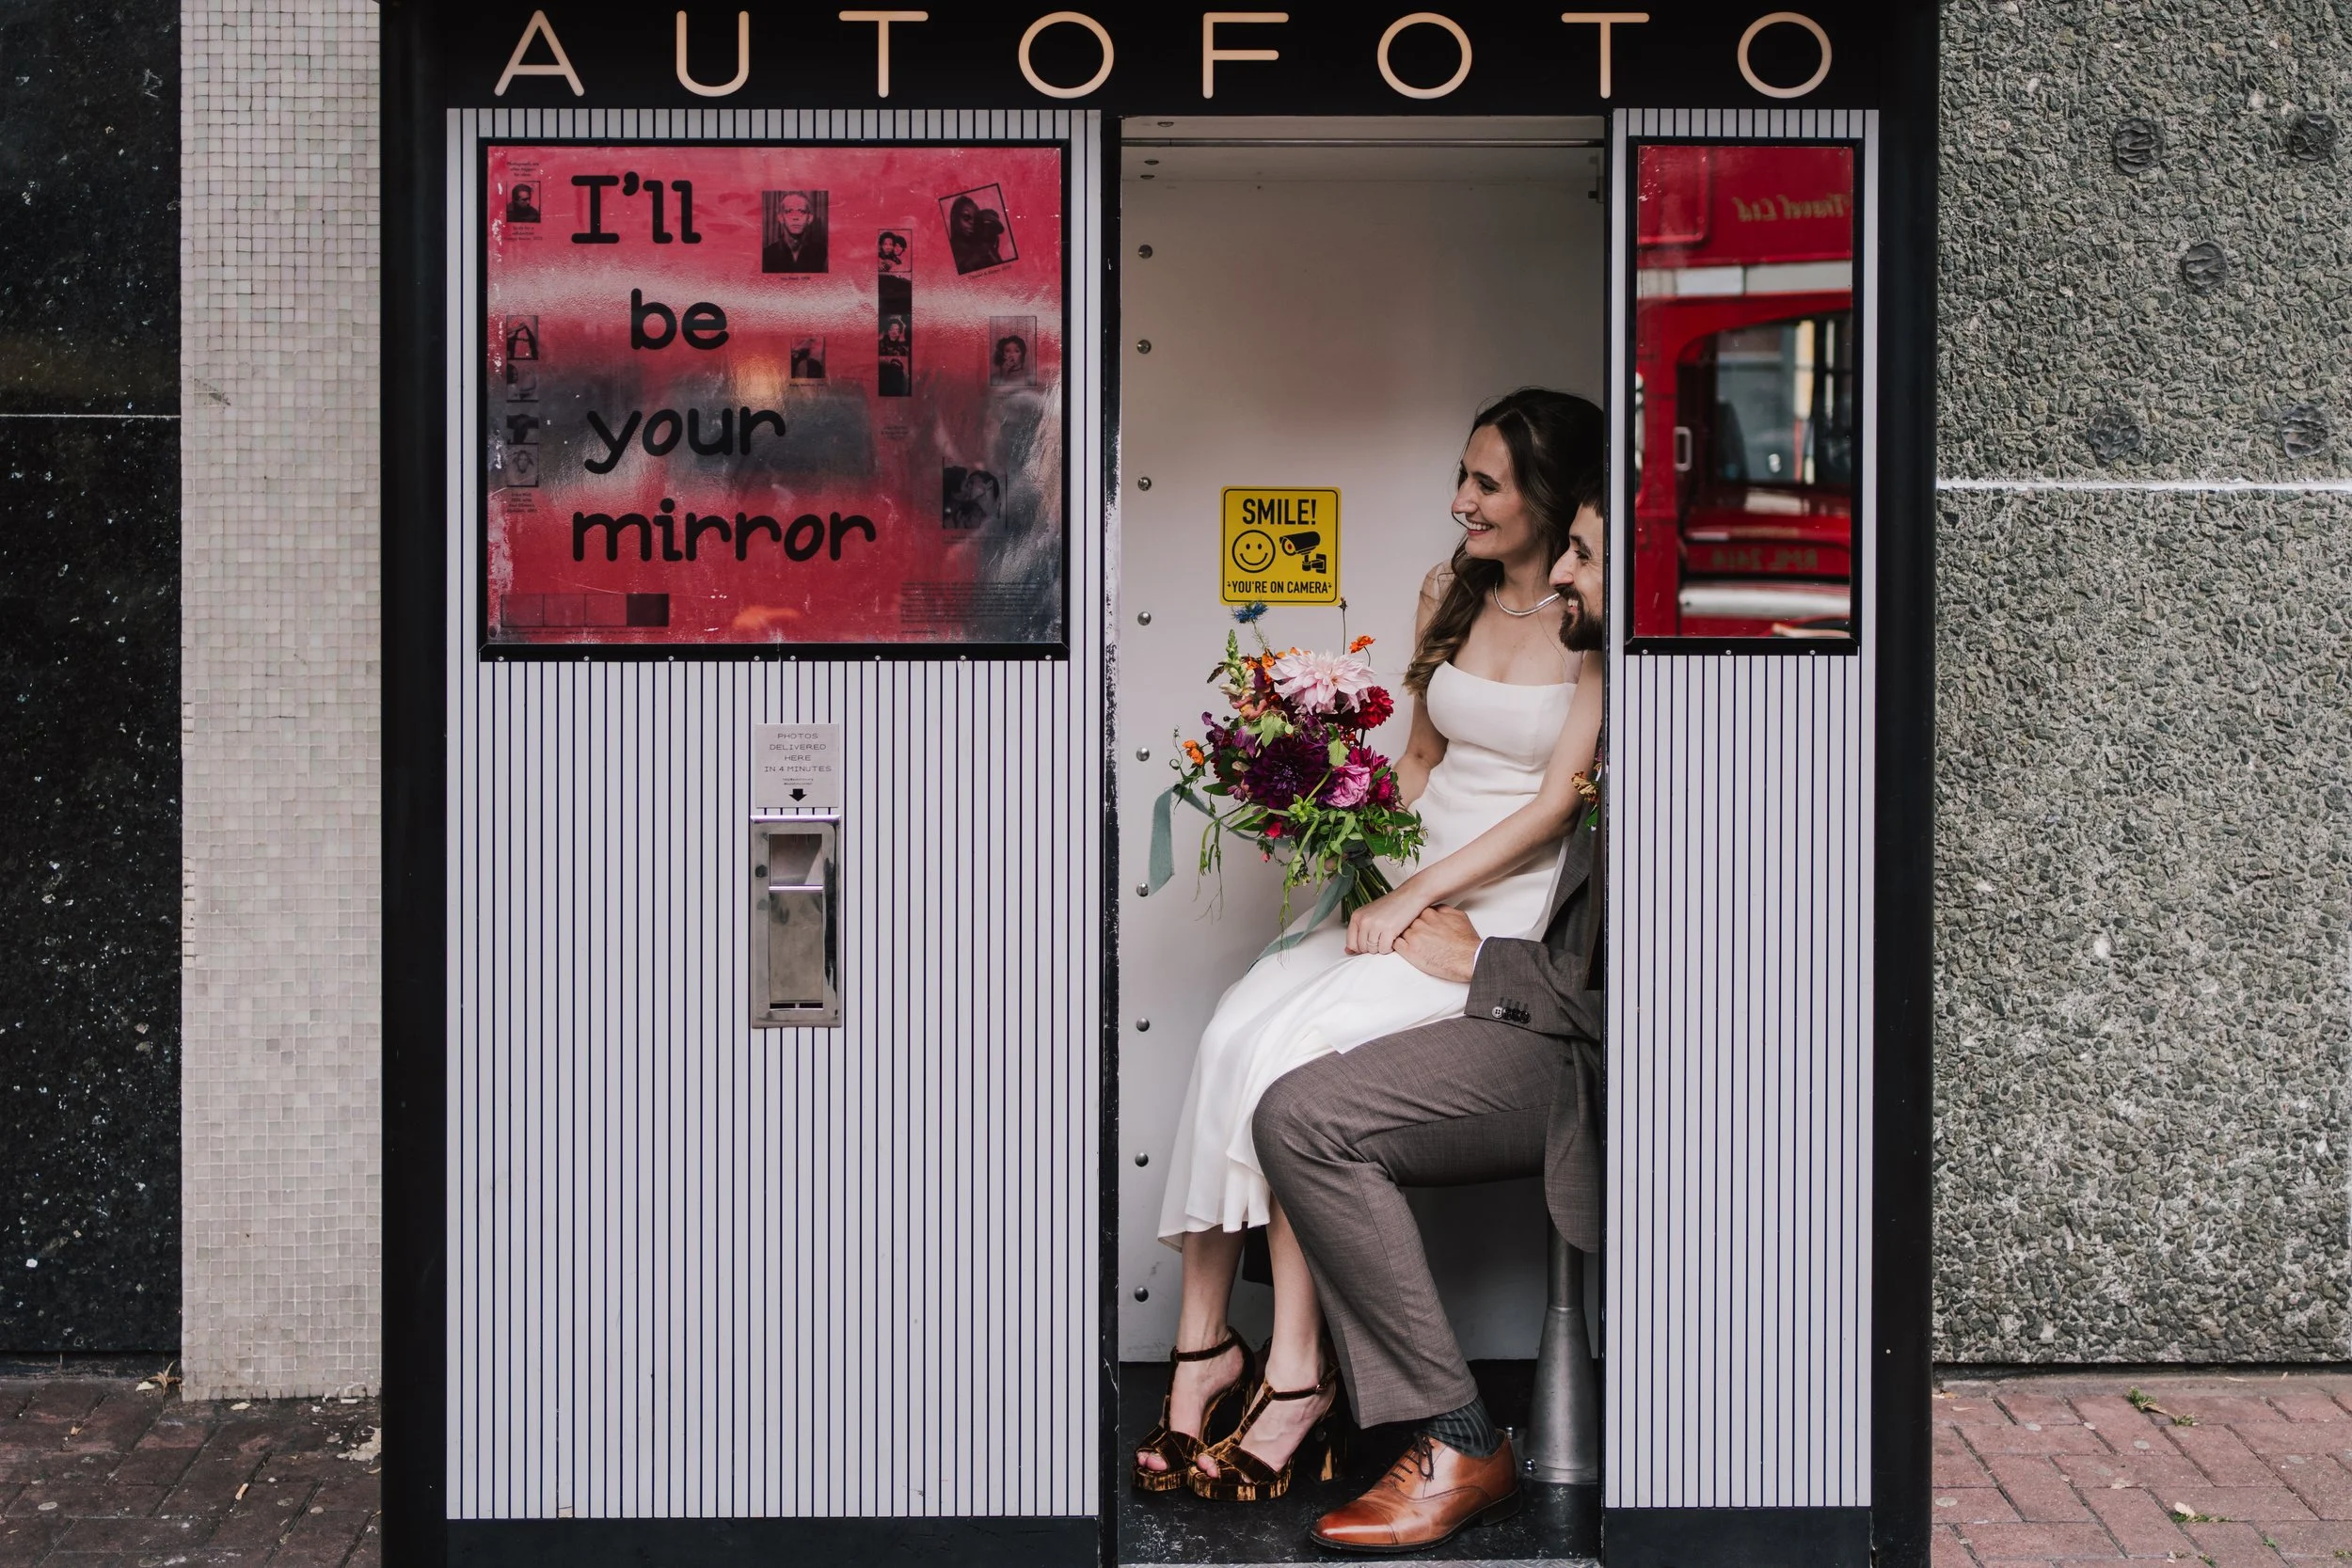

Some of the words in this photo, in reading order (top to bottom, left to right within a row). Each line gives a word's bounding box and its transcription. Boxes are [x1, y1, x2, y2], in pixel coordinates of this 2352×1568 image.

[494, 9, 1833, 100] AUTOFOTO
[570, 170, 703, 245] I'll
[630, 288, 730, 351] be
[583, 406, 787, 474] your
[572, 497, 877, 562] mirror
[1242, 498, 1317, 526] SMILE!
[1232, 580, 1267, 594] YOU'RE
[1270, 580, 1284, 594] ON
[1287, 580, 1328, 594] CAMERA
